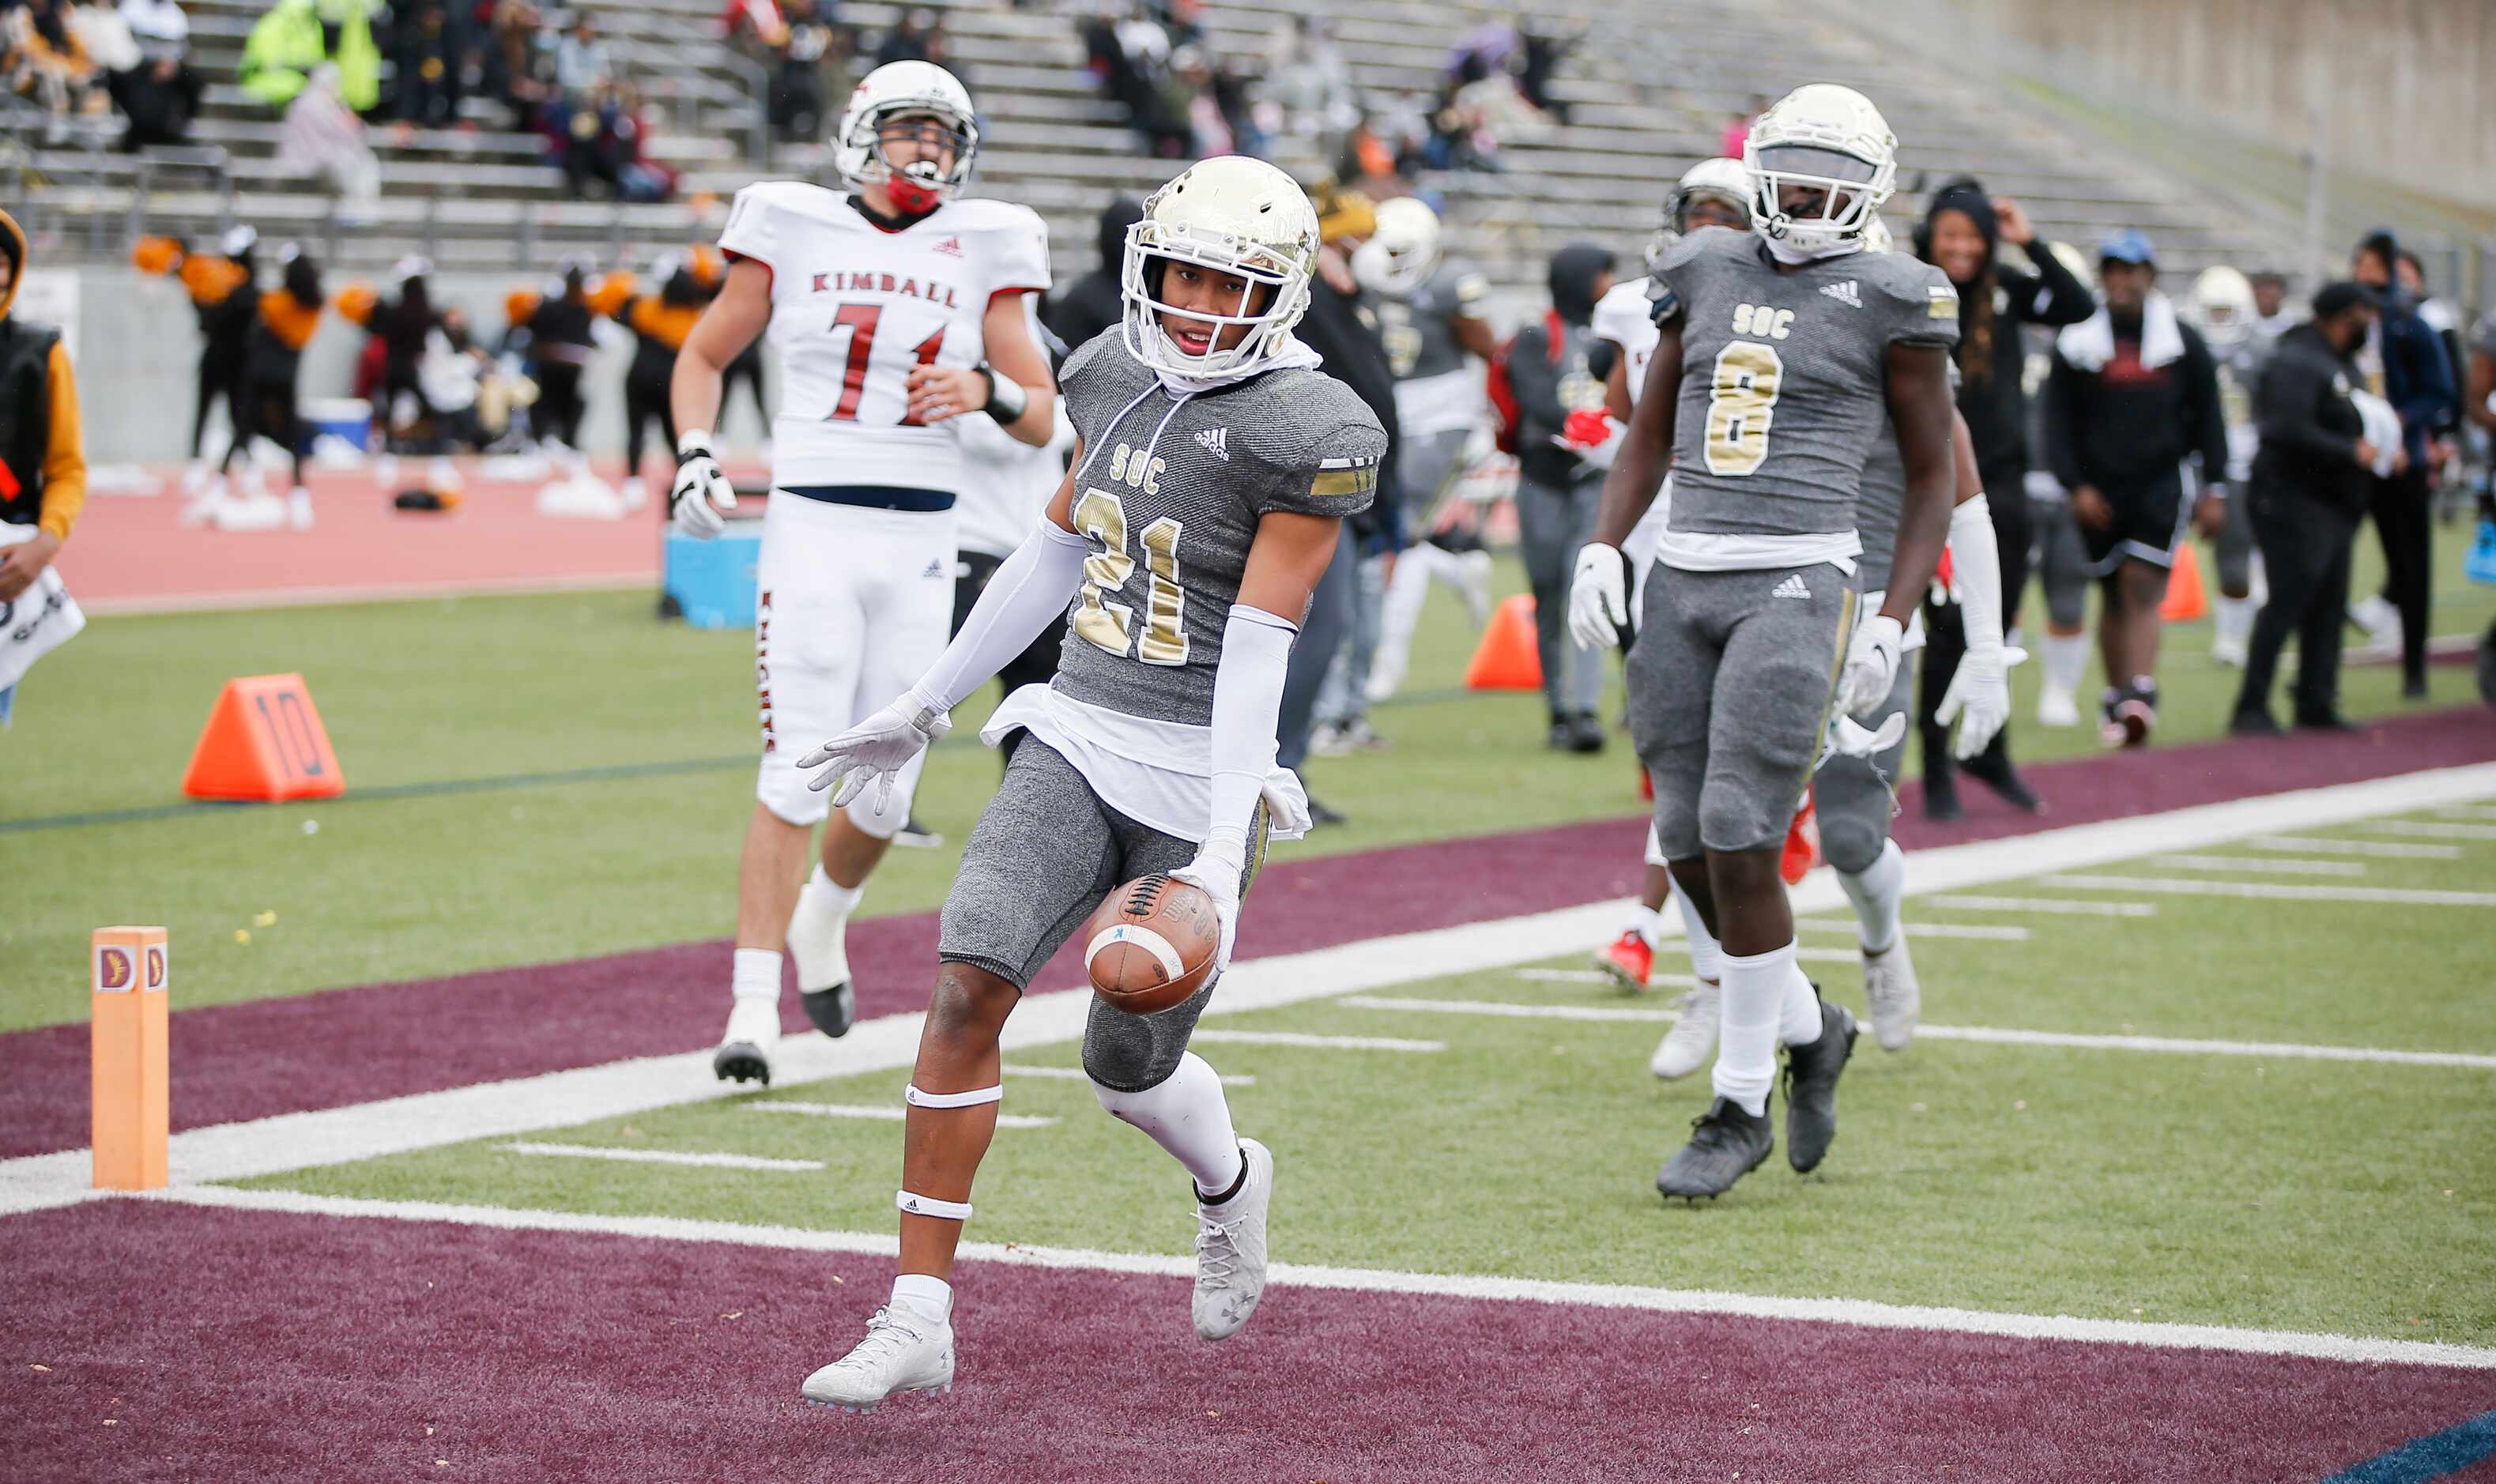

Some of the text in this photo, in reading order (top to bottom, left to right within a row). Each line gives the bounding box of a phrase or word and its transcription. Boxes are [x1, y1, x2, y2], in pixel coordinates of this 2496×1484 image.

[812, 273, 958, 308] KIMBALL
[1732, 303, 1796, 340] SOC
[1703, 340, 1784, 477] 8
[1109, 443, 1167, 495] SOC
[1194, 432, 1231, 461] adidas
[1073, 487, 1190, 666] 21
[256, 691, 324, 778] 10
